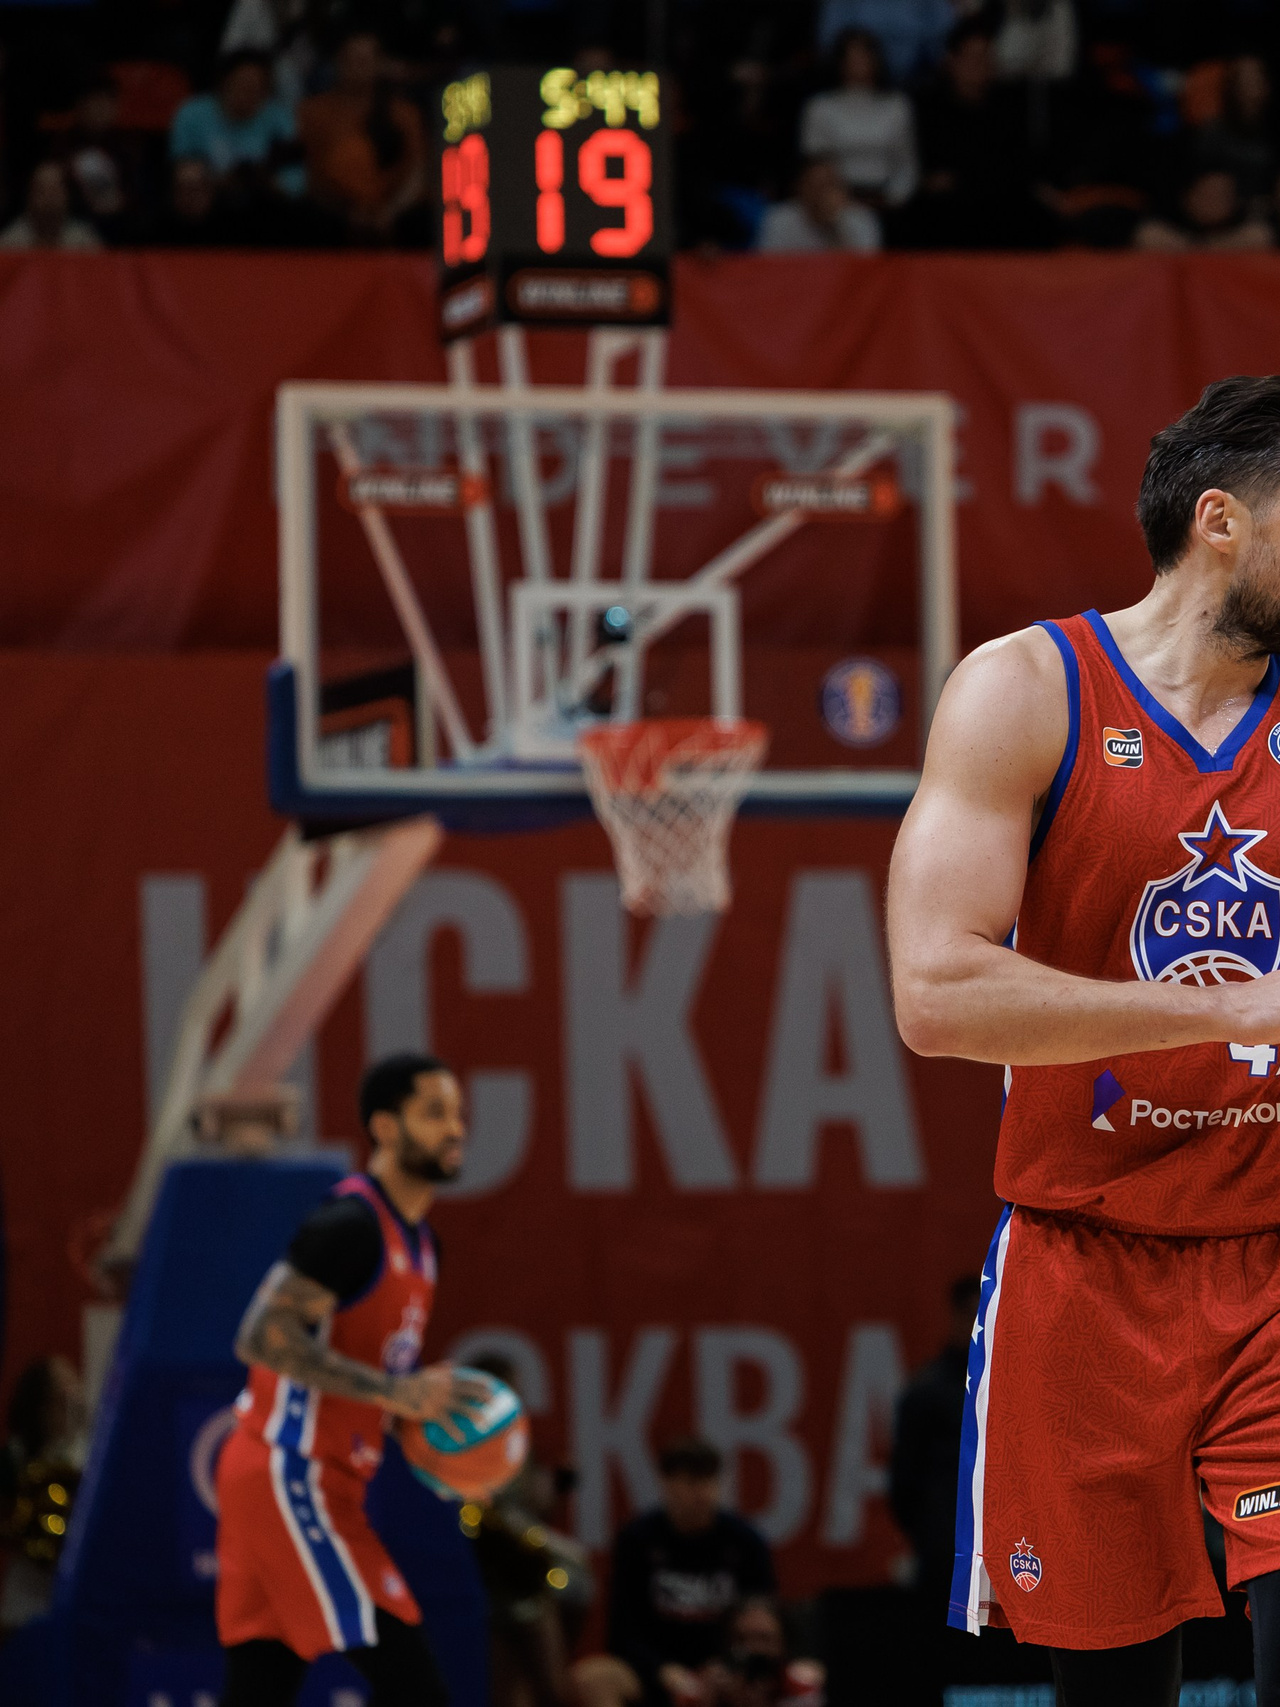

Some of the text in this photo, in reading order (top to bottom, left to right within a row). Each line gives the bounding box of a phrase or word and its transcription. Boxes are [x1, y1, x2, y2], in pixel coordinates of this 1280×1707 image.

[539, 67, 661, 130] 5:44
[535, 128, 654, 259] 19
[1112, 742, 1140, 754] WIN
[1154, 901, 1273, 939] CSKA
[1013, 1558, 1039, 1571] CSKA
